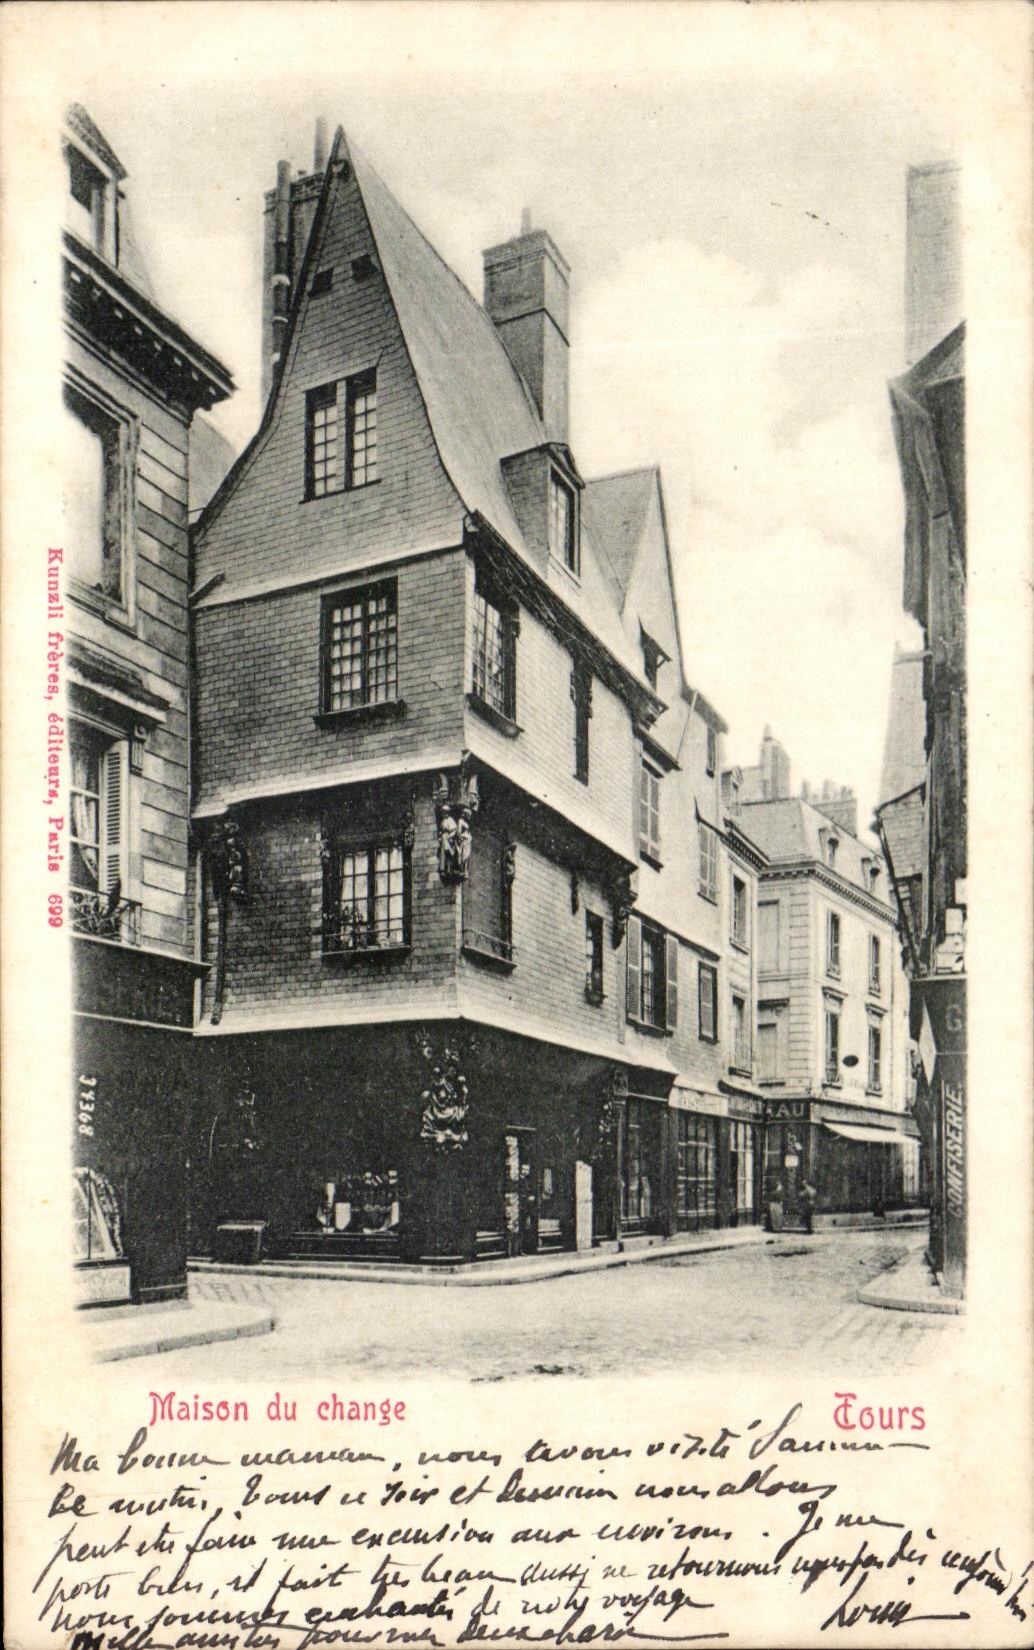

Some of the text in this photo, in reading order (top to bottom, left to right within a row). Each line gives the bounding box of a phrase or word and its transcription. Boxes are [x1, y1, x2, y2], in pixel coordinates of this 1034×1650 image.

[50, 1432, 99, 1475] Ma
[117, 1427, 230, 1475] bonne
[418, 1449, 501, 1466] nous
[450, 1475, 494, 1505] et
[634, 1483, 710, 1500] nous
[716, 1464, 837, 1499] allons
[774, 1500, 823, 1566] Je
[226, 1556, 268, 1593] il
[261, 1562, 362, 1618] fait
